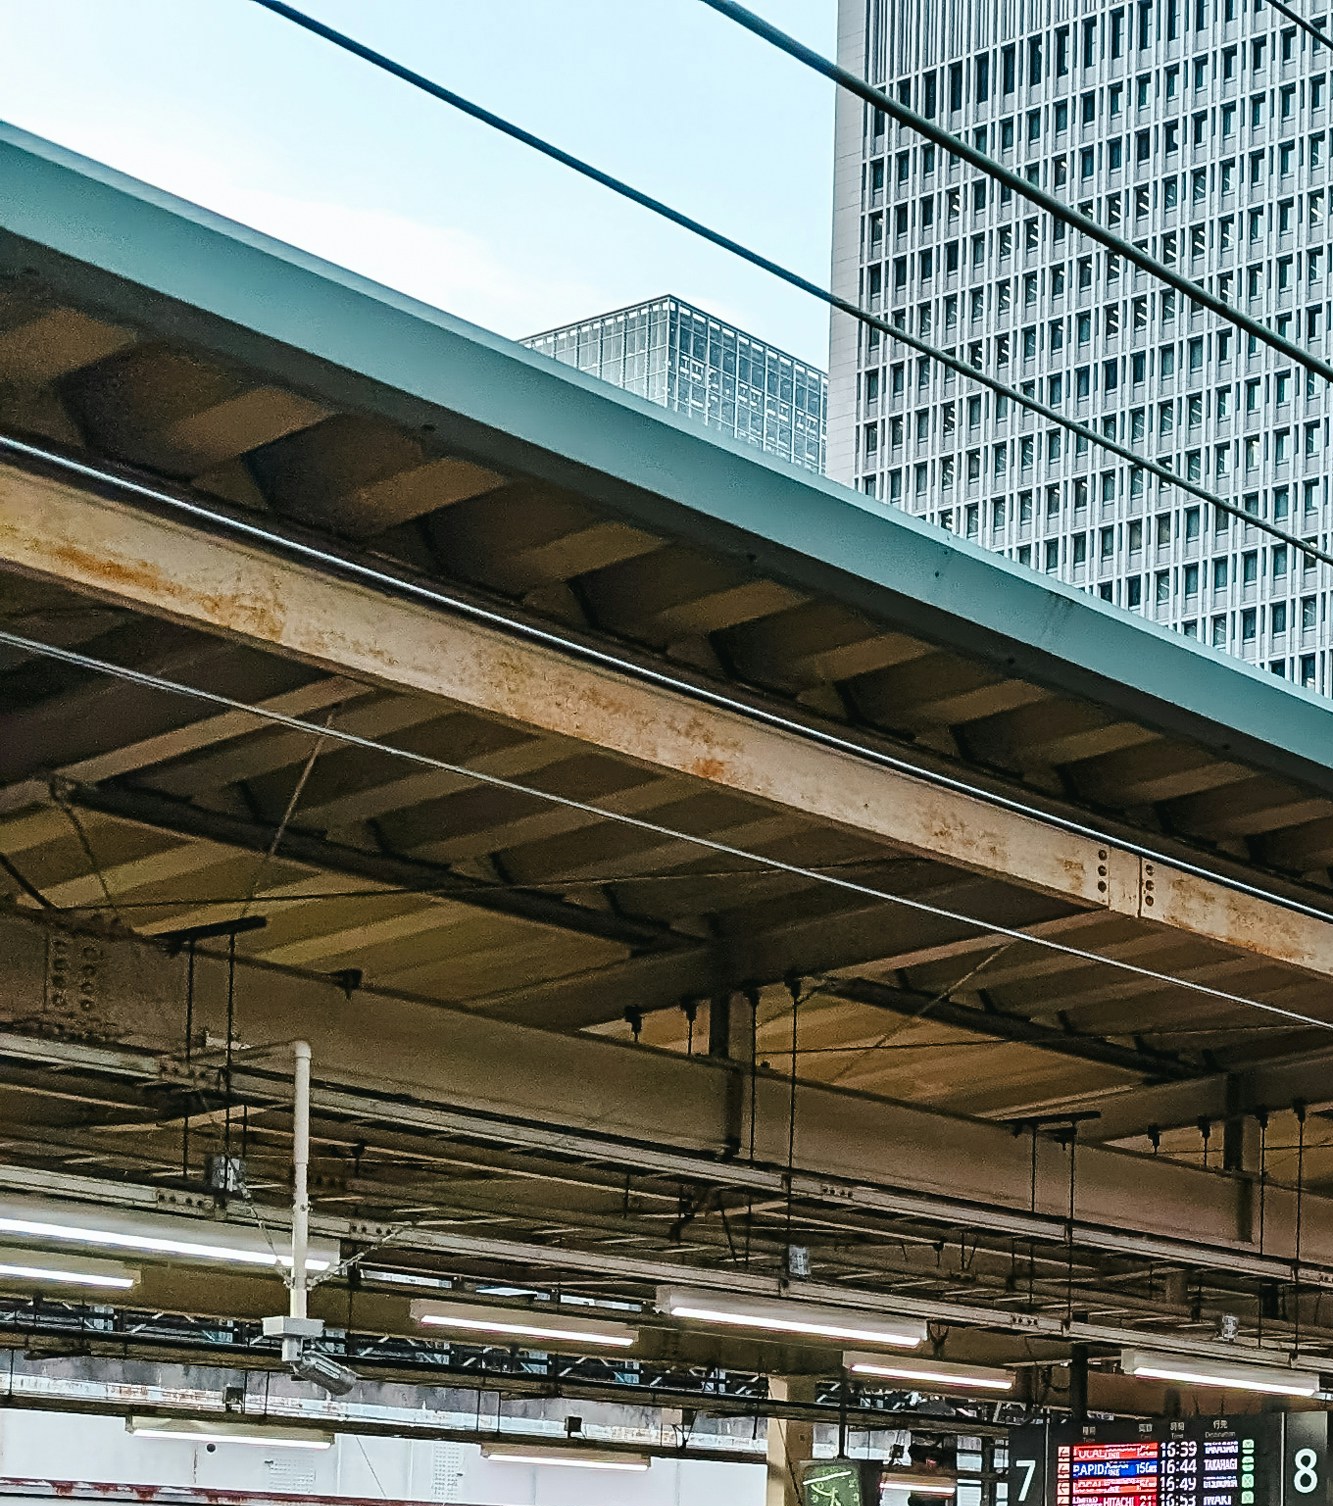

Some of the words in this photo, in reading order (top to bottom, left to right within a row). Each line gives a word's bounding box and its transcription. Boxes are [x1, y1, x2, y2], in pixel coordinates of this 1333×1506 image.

[1160, 1441, 1197, 1457] 16:39
[1073, 1464, 1105, 1475] RAPID
[1160, 1459, 1197, 1474] 16:44
[1203, 1458, 1238, 1471] TAKAHAGI
[1293, 1448, 1318, 1493] 8
[1016, 1459, 1036, 1502] 7
[1160, 1476, 1197, 1491] 16:49
